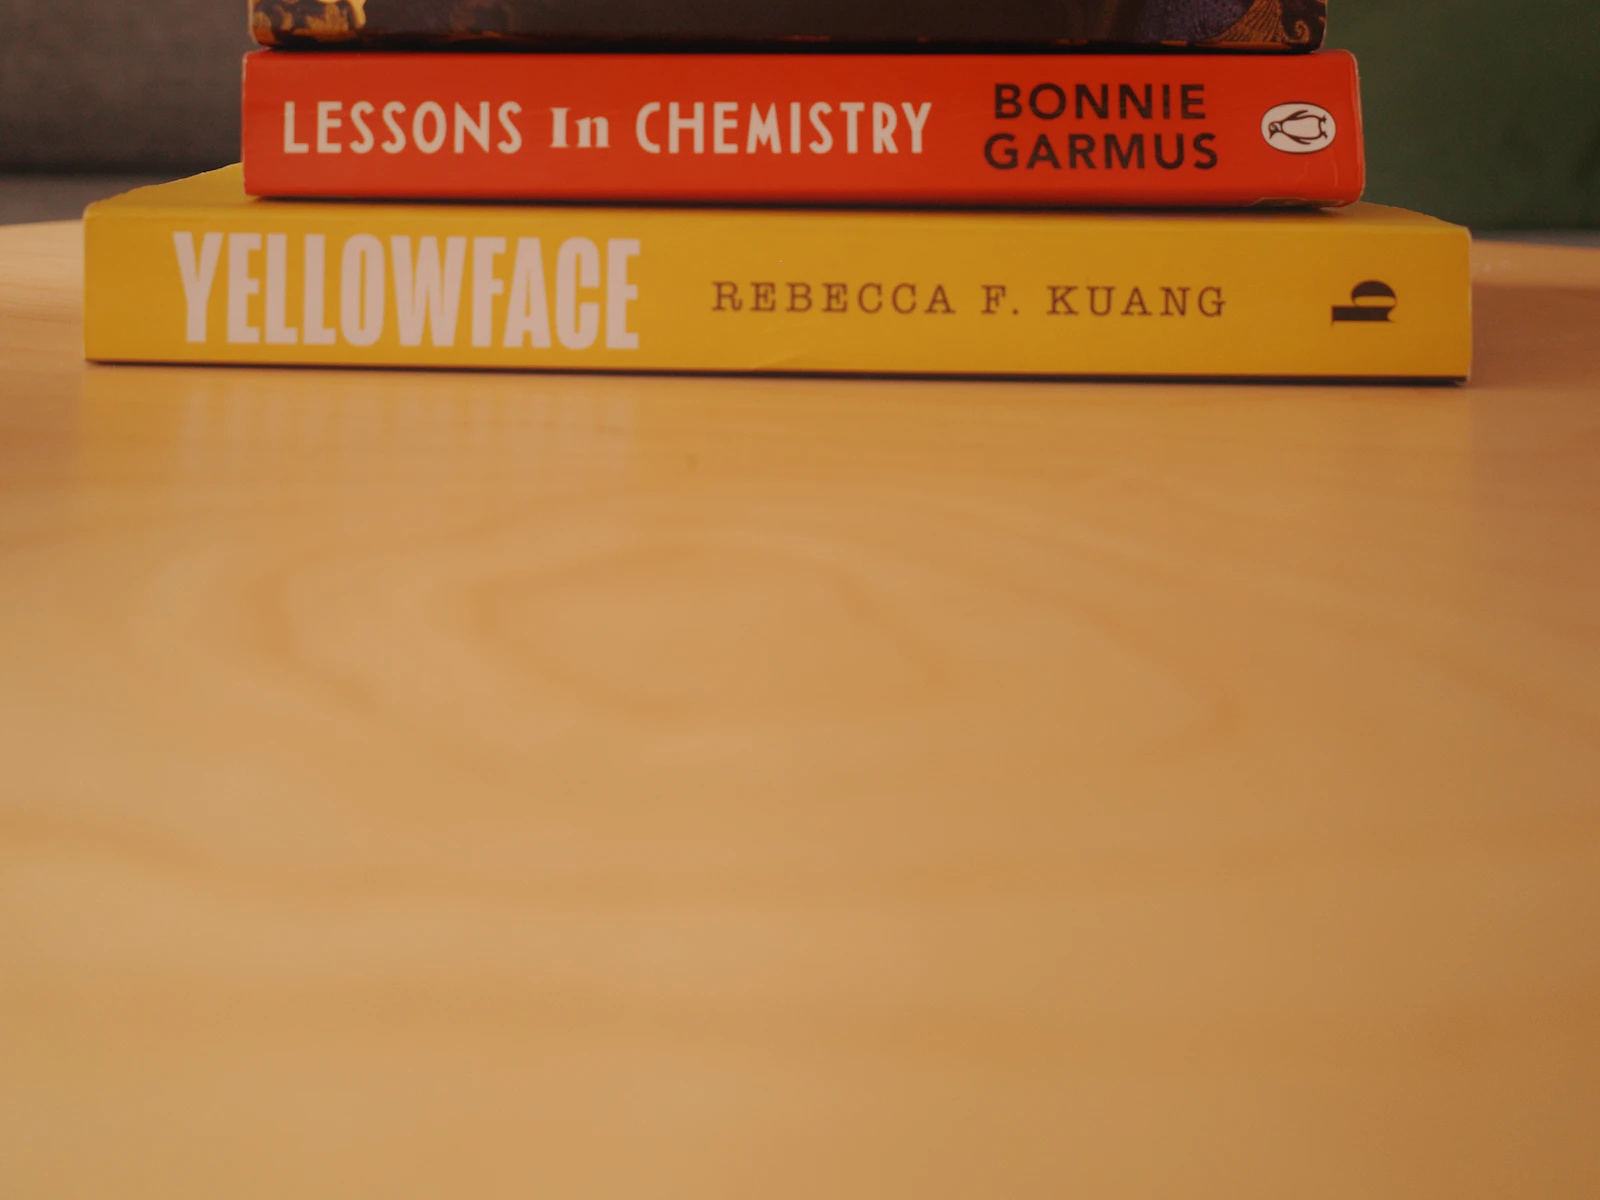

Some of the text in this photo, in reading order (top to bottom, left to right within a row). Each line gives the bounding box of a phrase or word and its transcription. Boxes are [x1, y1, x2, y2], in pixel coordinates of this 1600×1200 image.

[994, 83, 1206, 120] BONNIE
[283, 100, 932, 155] LESSONS In CHEMISTRY
[984, 132, 1219, 170] GARMUS
[172, 231, 641, 350] YELLOWFACE
[711, 280, 1228, 318] REBECCA F. KUANG
